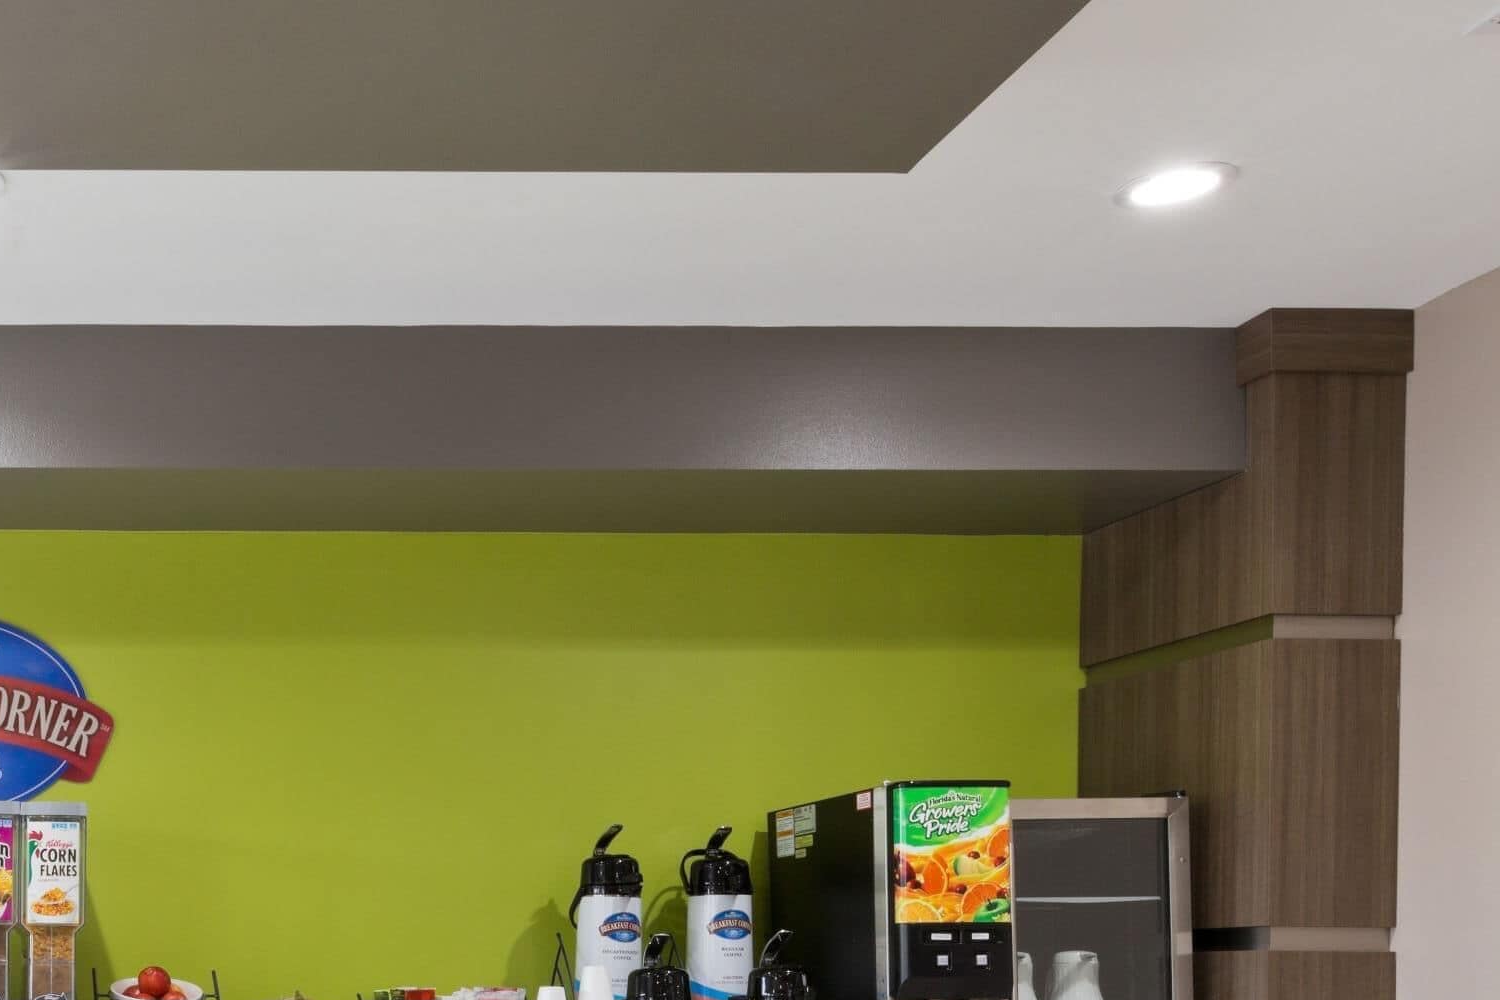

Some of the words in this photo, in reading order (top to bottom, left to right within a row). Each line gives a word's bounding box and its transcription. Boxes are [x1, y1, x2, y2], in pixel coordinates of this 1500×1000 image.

[923, 816, 969, 838] Pride
[40, 848, 77, 863] CORN
[40, 865, 77, 877] FLAKES
